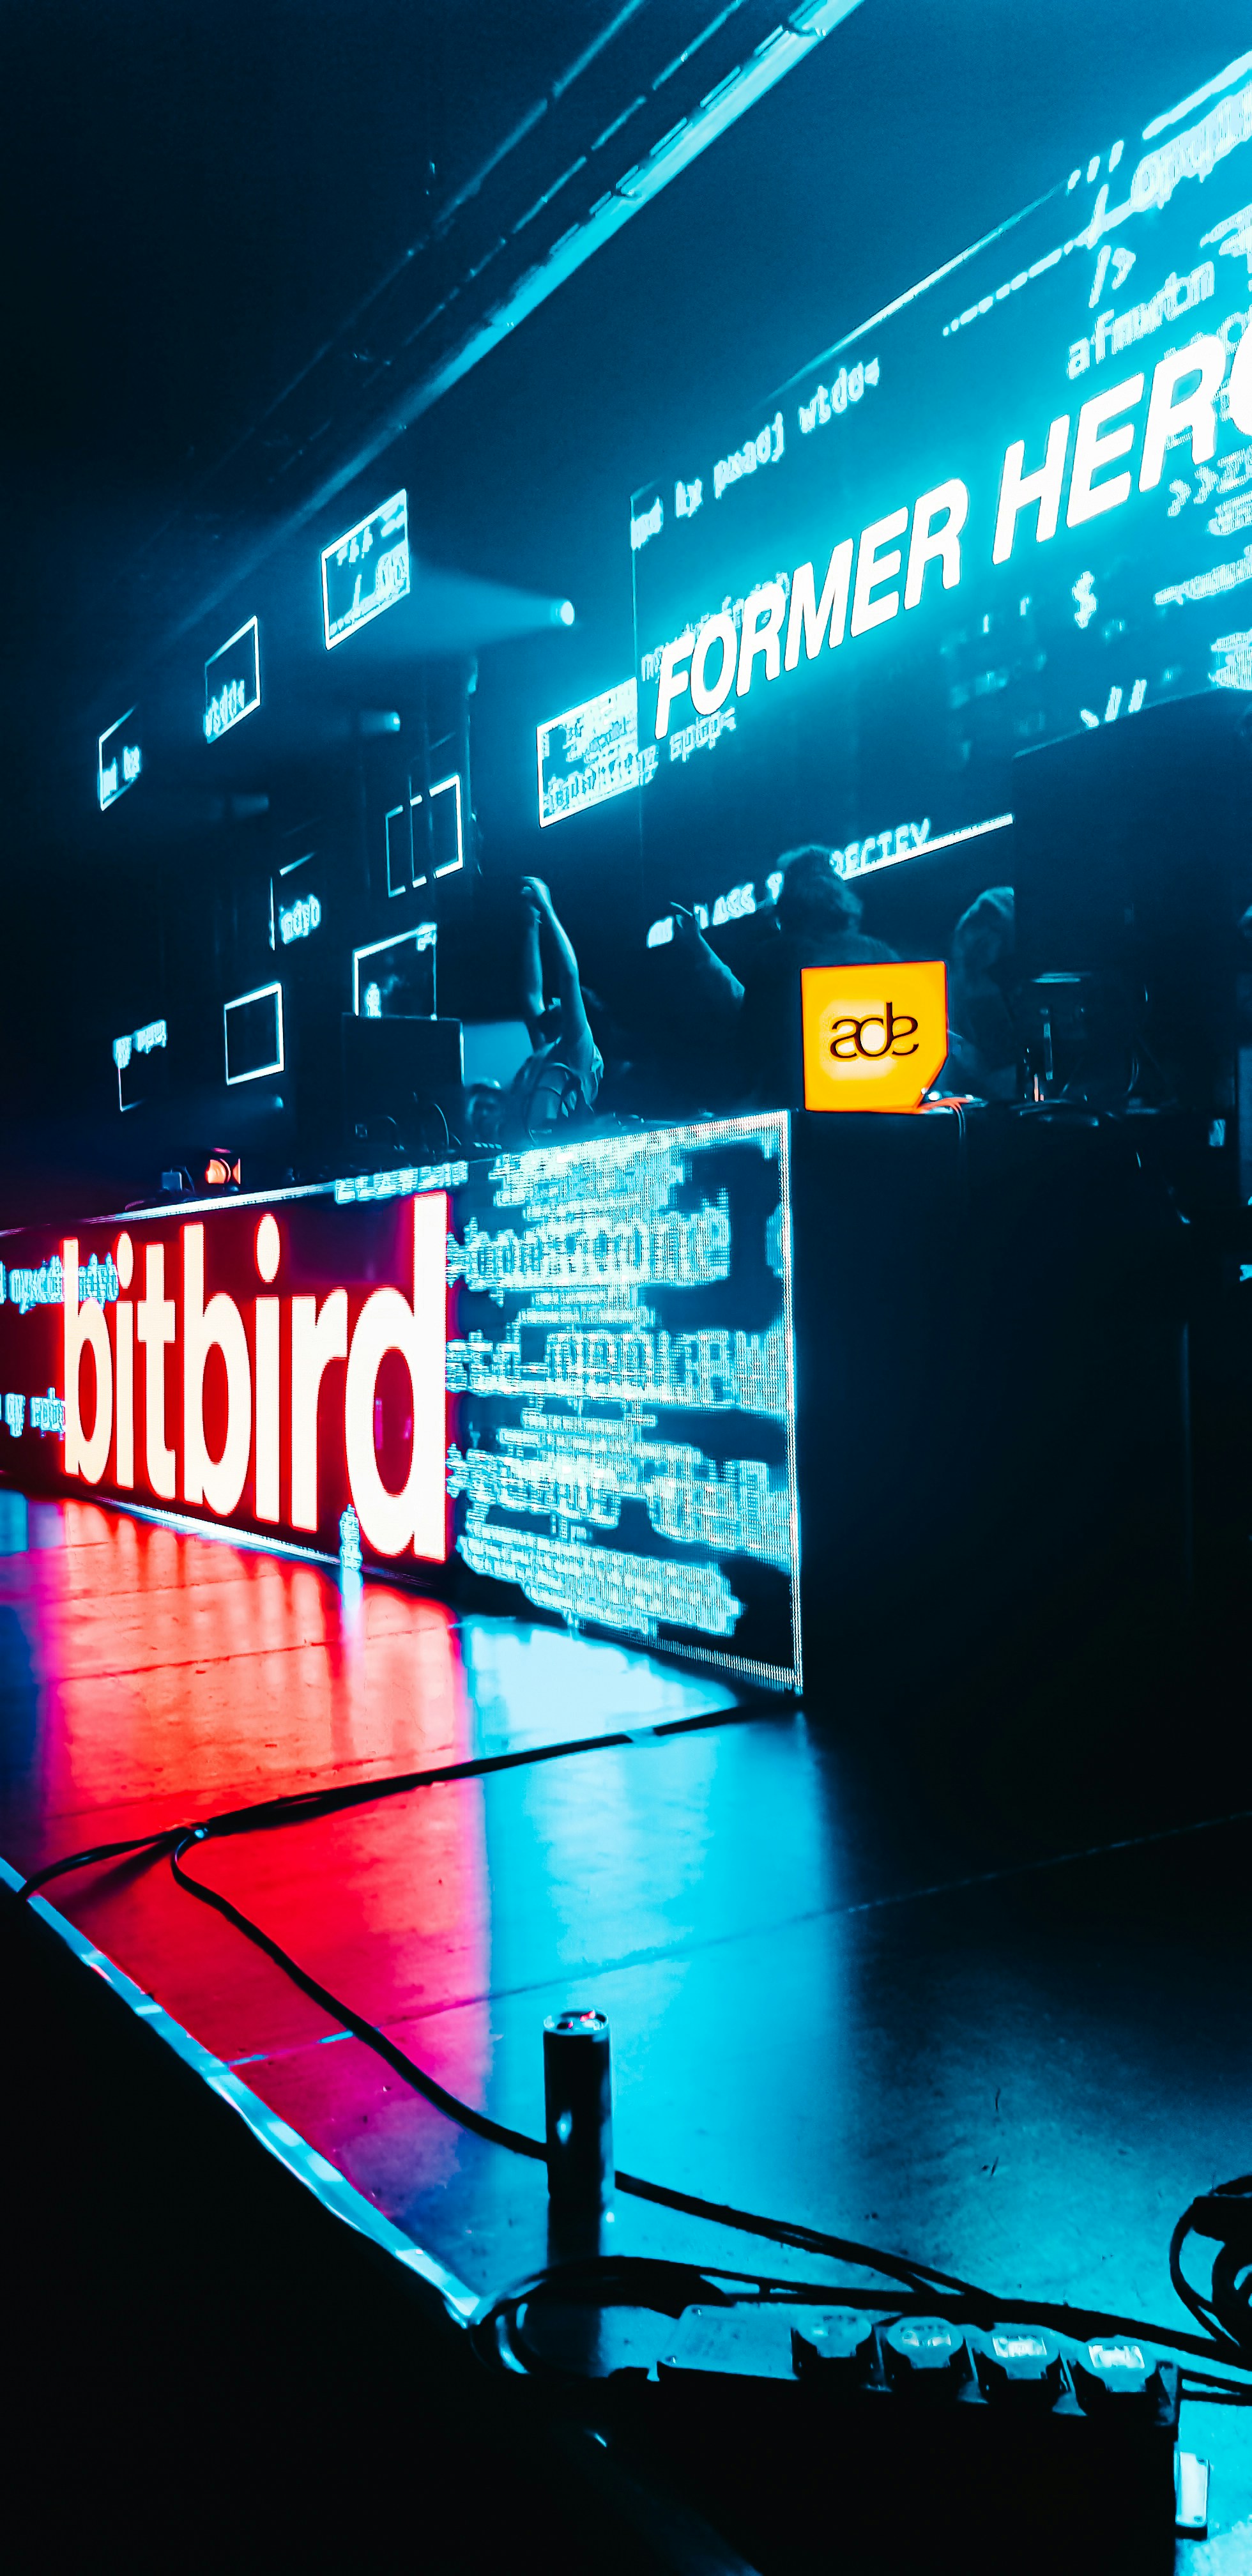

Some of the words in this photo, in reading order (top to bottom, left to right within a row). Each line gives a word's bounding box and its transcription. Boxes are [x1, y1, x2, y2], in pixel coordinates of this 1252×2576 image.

[654, 479, 968, 740] FORMER
[830, 1002, 919, 1059] ade
[62, 1189, 448, 1563] bitbird
